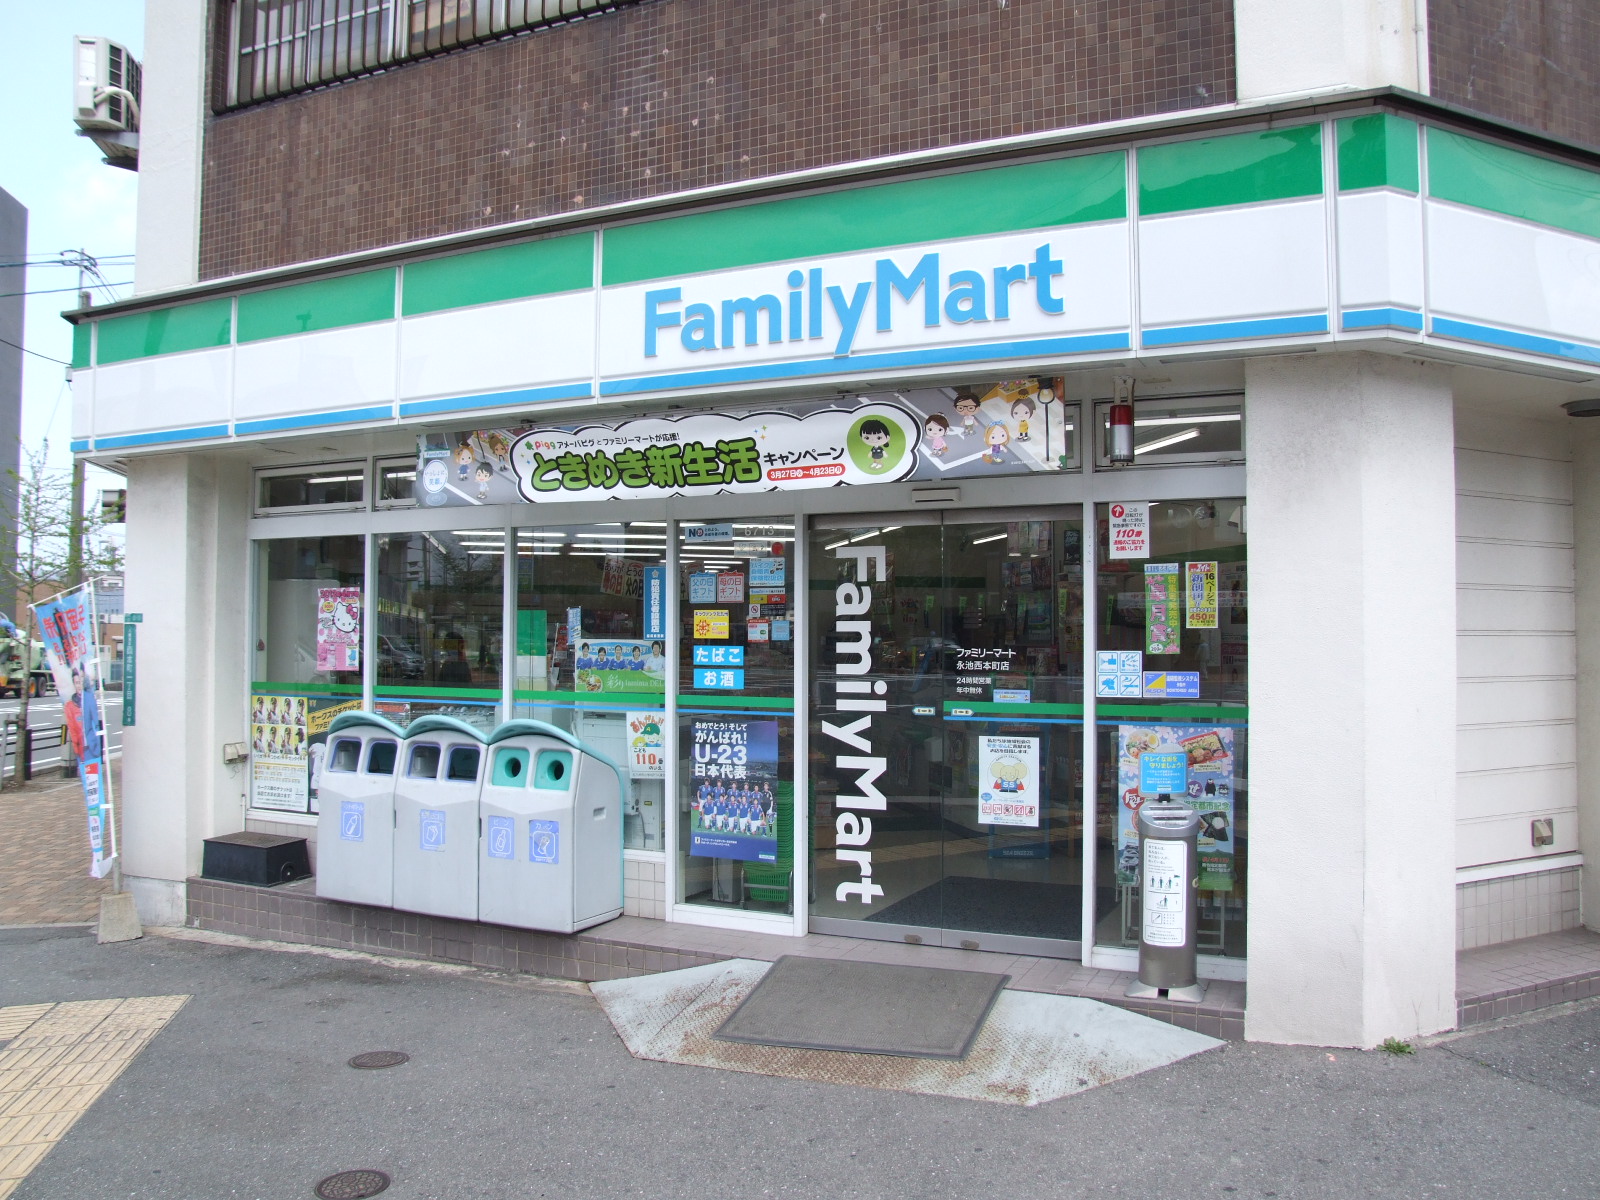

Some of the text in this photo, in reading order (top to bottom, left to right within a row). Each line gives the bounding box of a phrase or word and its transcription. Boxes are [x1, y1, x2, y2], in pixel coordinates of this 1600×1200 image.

[644, 243, 1065, 358] FamilyMart
[763, 447, 845, 466] キャンペーン
[531, 437, 762, 492] ときめき新生活
[744, 526, 775, 537] 6713
[1115, 529, 1143, 538] 110番
[692, 578, 714, 587] 父の日
[720, 578, 742, 586] 母の日
[692, 587, 714, 596] ギフト
[720, 587, 741, 595] ギフト
[1204, 573, 1215, 606] 16ページで
[1149, 583, 1167, 642] 皐月賞
[696, 647, 741, 663] たばこ
[956, 648, 1017, 658] ファミリーマート
[956, 661, 1010, 671] 永池西本町店
[703, 671, 735, 687] お酒
[956, 677, 992, 685] 24時間営業
[821, 546, 887, 904] FamilyMart
[695, 731, 748, 744] がんばれ!
[694, 744, 748, 764] U-23
[694, 764, 747, 779] 日本代表
